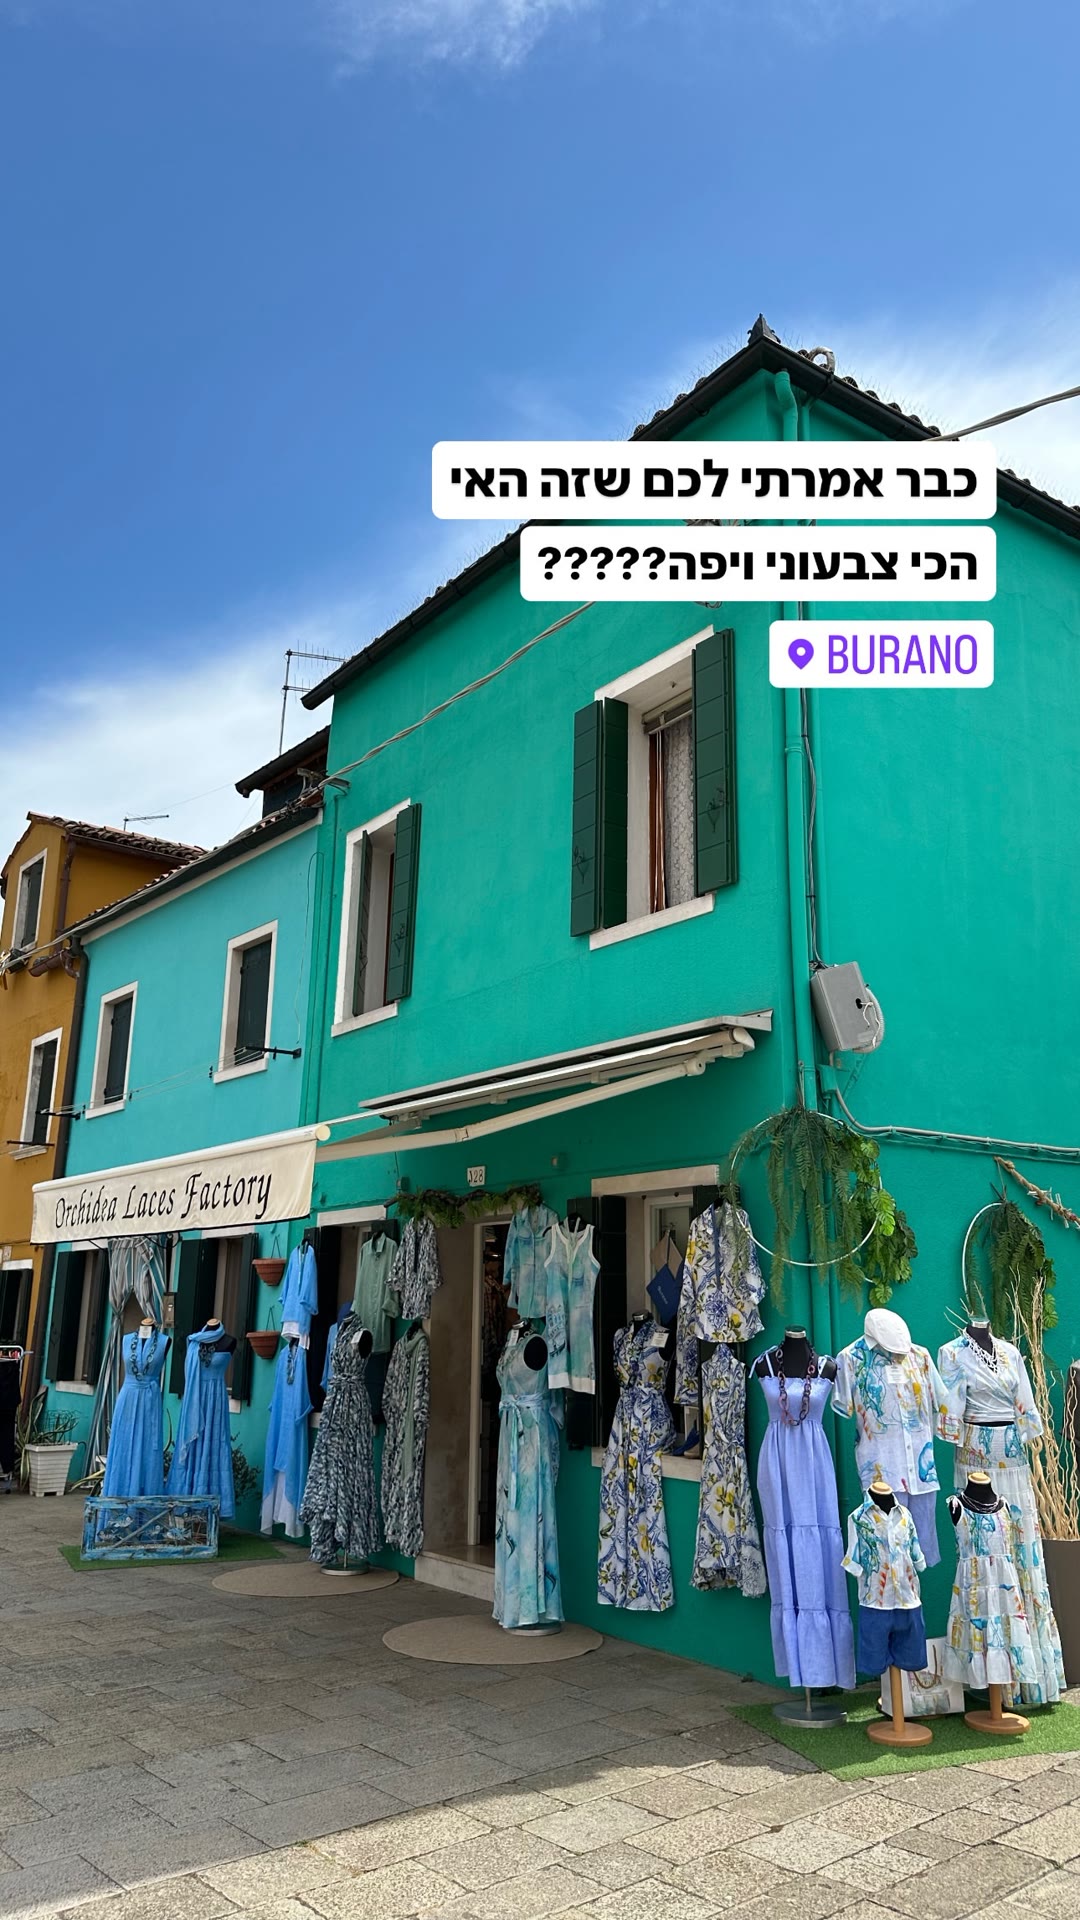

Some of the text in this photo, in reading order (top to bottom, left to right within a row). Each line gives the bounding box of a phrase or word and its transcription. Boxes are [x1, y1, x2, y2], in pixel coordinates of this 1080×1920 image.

[55, 1172, 273, 1229] Orchidea Laces Factory
